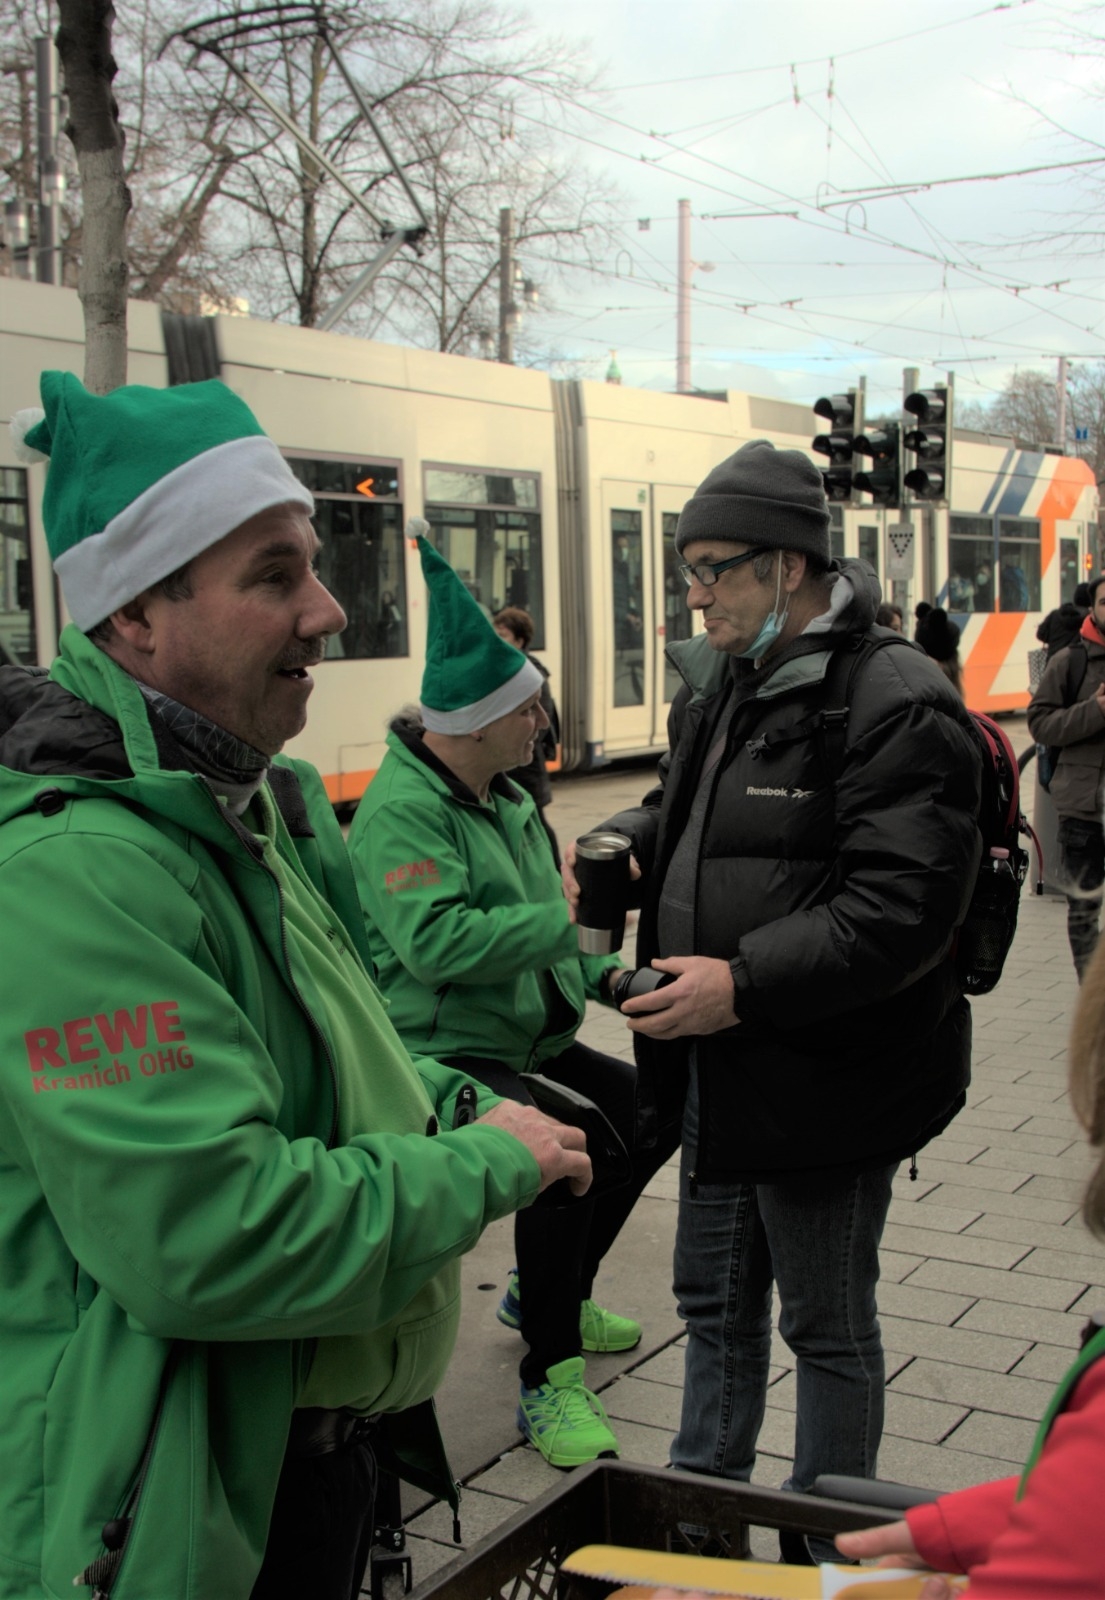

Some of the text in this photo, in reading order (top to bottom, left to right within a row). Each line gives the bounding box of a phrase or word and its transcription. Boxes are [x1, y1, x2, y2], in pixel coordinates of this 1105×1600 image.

[746, 786, 788, 797] Reebok
[385, 858, 438, 886] REWE
[24, 1000, 186, 1072] REWE
[32, 1045, 195, 1094] Kranich OHG
